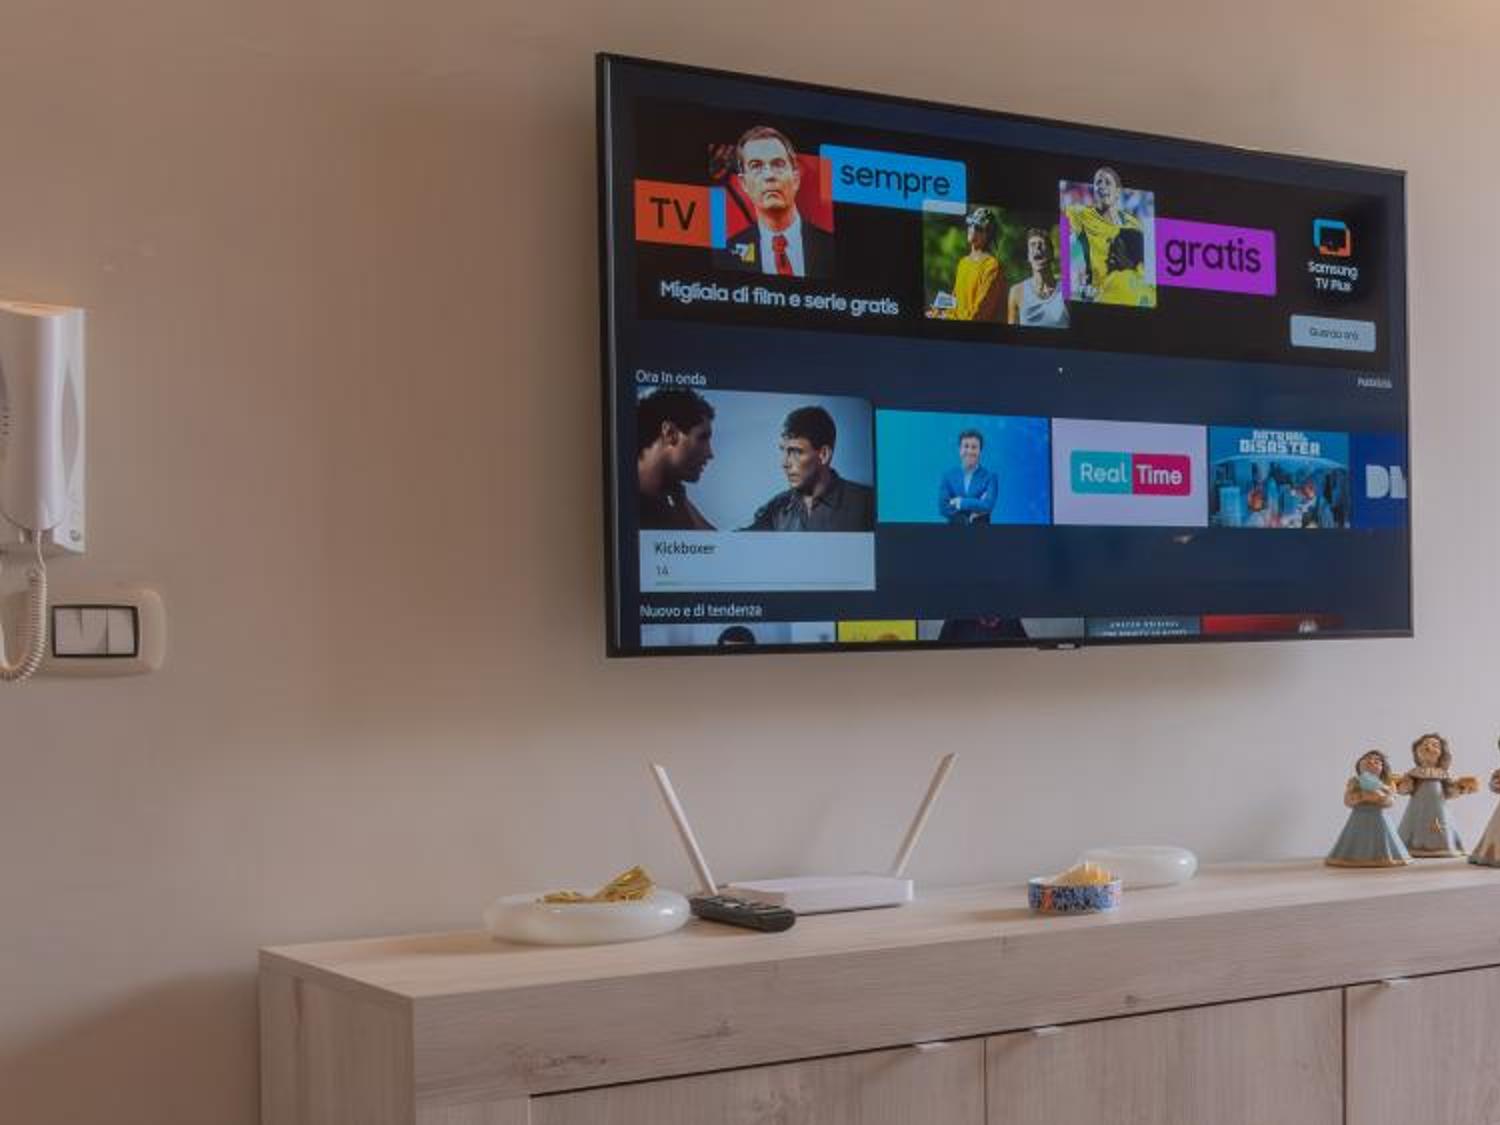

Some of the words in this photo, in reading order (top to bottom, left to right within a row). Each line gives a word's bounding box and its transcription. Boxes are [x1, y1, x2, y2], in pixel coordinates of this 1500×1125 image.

[841, 164, 951, 199] sempre
[649, 197, 696, 231] TV
[1164, 237, 1262, 277] gratis
[1306, 261, 1358, 280] Samsung
[1315, 277, 1329, 289] TV
[660, 280, 729, 303] Migliaia
[732, 286, 749, 303] di
[753, 287, 785, 306] film
[789, 292, 801, 306] e
[804, 291, 847, 311] serie
[851, 296, 899, 316] gratis
[635, 369, 659, 383] Ora
[661, 370, 673, 384] in
[675, 372, 707, 385] onda
[1079, 463, 1128, 484] Real
[1135, 464, 1183, 485] Time
[655, 541, 717, 555] Kickboxer
[639, 603, 680, 617] Nuovo
[683, 606, 691, 617] e
[693, 602, 705, 617] di
[707, 602, 763, 618] tendenza
